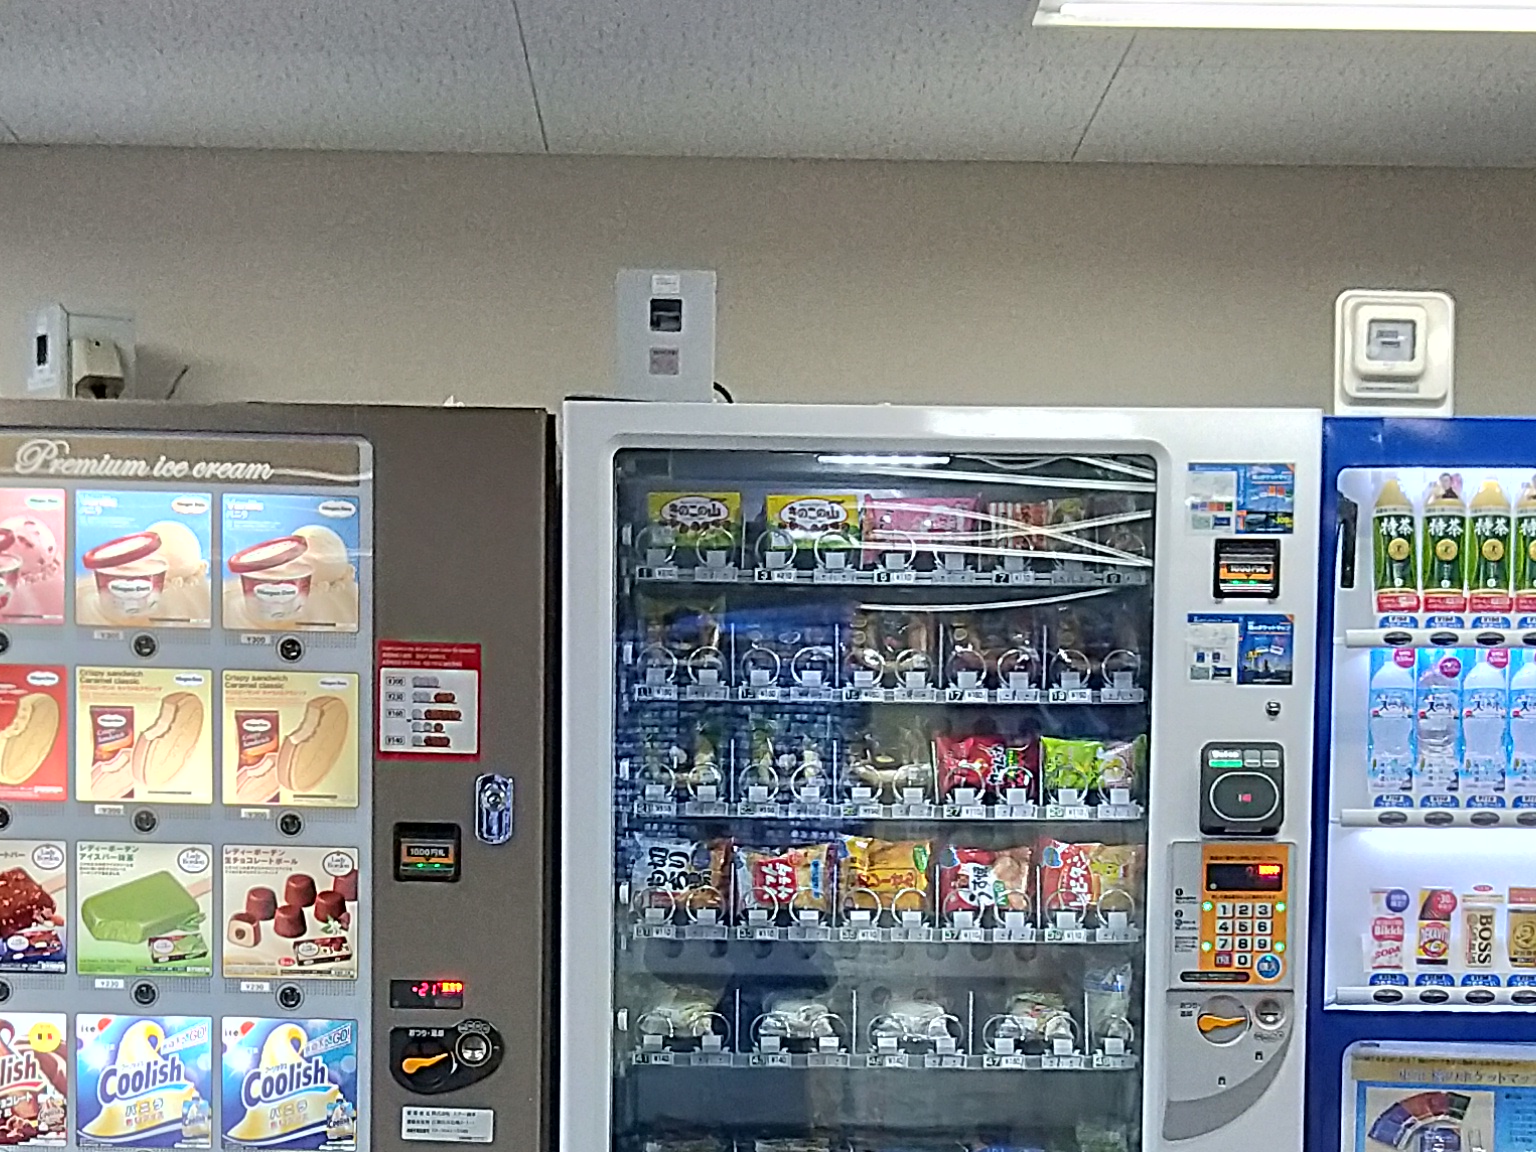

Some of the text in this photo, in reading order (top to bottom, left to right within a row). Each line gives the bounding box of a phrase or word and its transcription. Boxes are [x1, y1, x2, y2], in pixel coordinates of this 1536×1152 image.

[14, 439, 275, 480] Premium ice cream
[1380, 517, 1415, 538] 特茶
[1428, 517, 1464, 538] 特茶
[1474, 517, 1510, 538] 特茶
[79, 669, 105, 678] Crispy
[225, 674, 289, 683] Crispy sandwich
[225, 682, 257, 690] Caramel
[1220, 904, 1228, 916] 1
[1238, 904, 1249, 916] 2
[1258, 904, 1269, 916] 3
[1218, 920, 1230, 932] 4
[1237, 920, 1248, 932] 5
[1257, 920, 1268, 932] 6
[1218, 938, 1229, 949] 7
[1237, 938, 1248, 949] 8
[1257, 938, 1268, 949] 9
[1477, 914, 1493, 965] BOSS
[1374, 945, 1401, 960] SODA
[1237, 954, 1248, 966] 0
[99, 1056, 183, 1104] Coolish
[244, 1058, 326, 1104] Coolish
